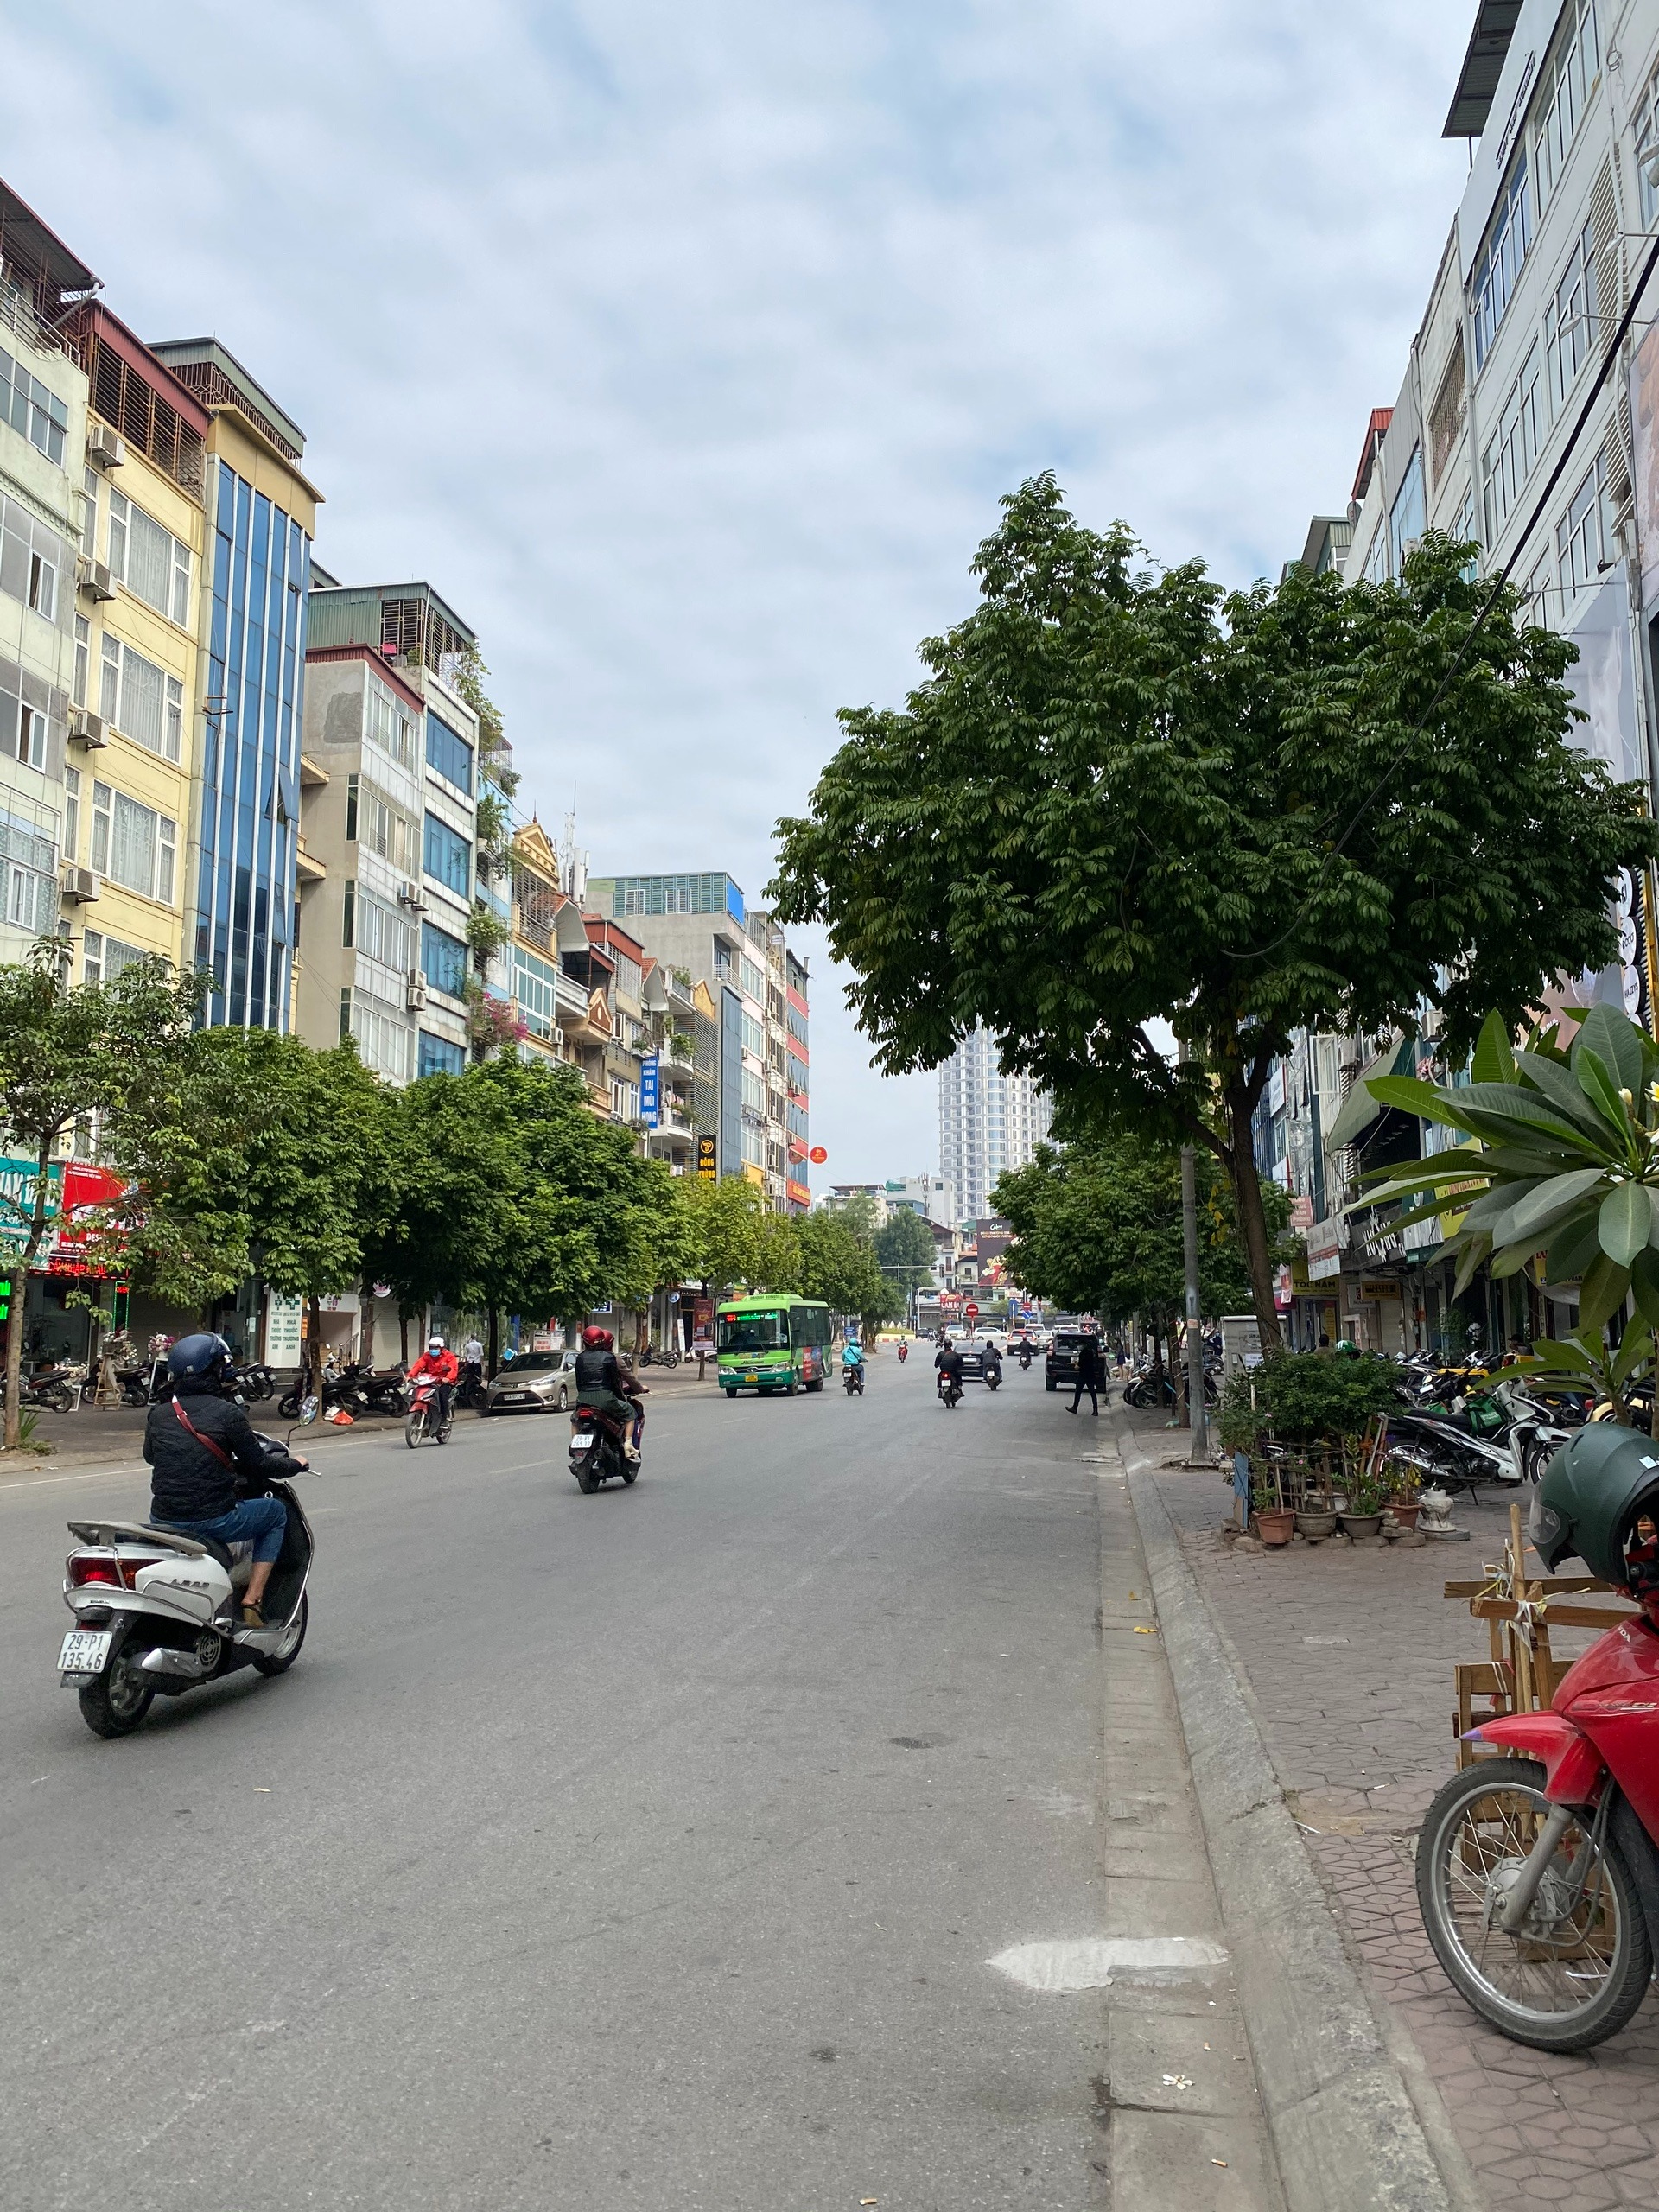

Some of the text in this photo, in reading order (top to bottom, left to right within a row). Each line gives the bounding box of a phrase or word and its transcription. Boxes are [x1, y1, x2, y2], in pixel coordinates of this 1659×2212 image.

[1624, 982, 1638, 999] HAZZYS
[645, 1079, 654, 1090] TAI
[67, 1634, 104, 1650] 29-P1
[61, 1652, 104, 1669] 135.46
